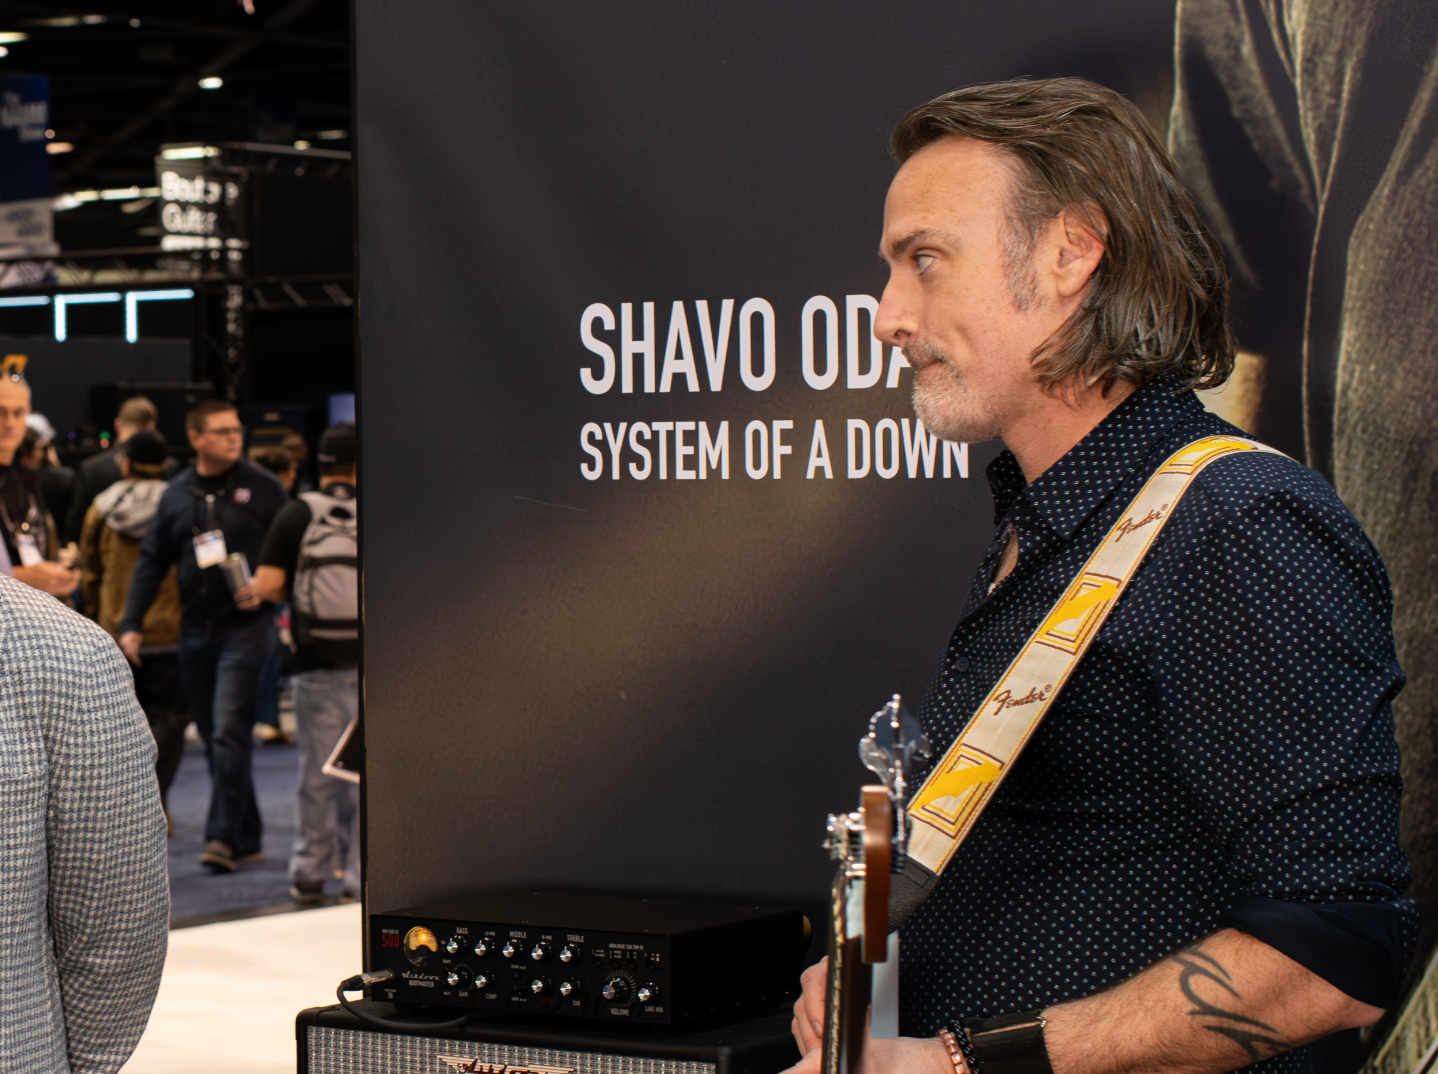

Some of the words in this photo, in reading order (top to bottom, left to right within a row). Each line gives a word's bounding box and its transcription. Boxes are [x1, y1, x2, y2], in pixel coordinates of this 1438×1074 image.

[579, 296, 776, 395] SHAVO
[579, 420, 730, 481] SYSTEM
[744, 419, 794, 480] OF
[805, 419, 834, 480] A
[846, 417, 970, 480] DOWN
[455, 926, 469, 935] BASS
[509, 930, 528, 939] MIDDLE
[381, 934, 400, 948] 500
[566, 934, 585, 943] TREBLE
[610, 1007, 630, 1017] VOLUME
